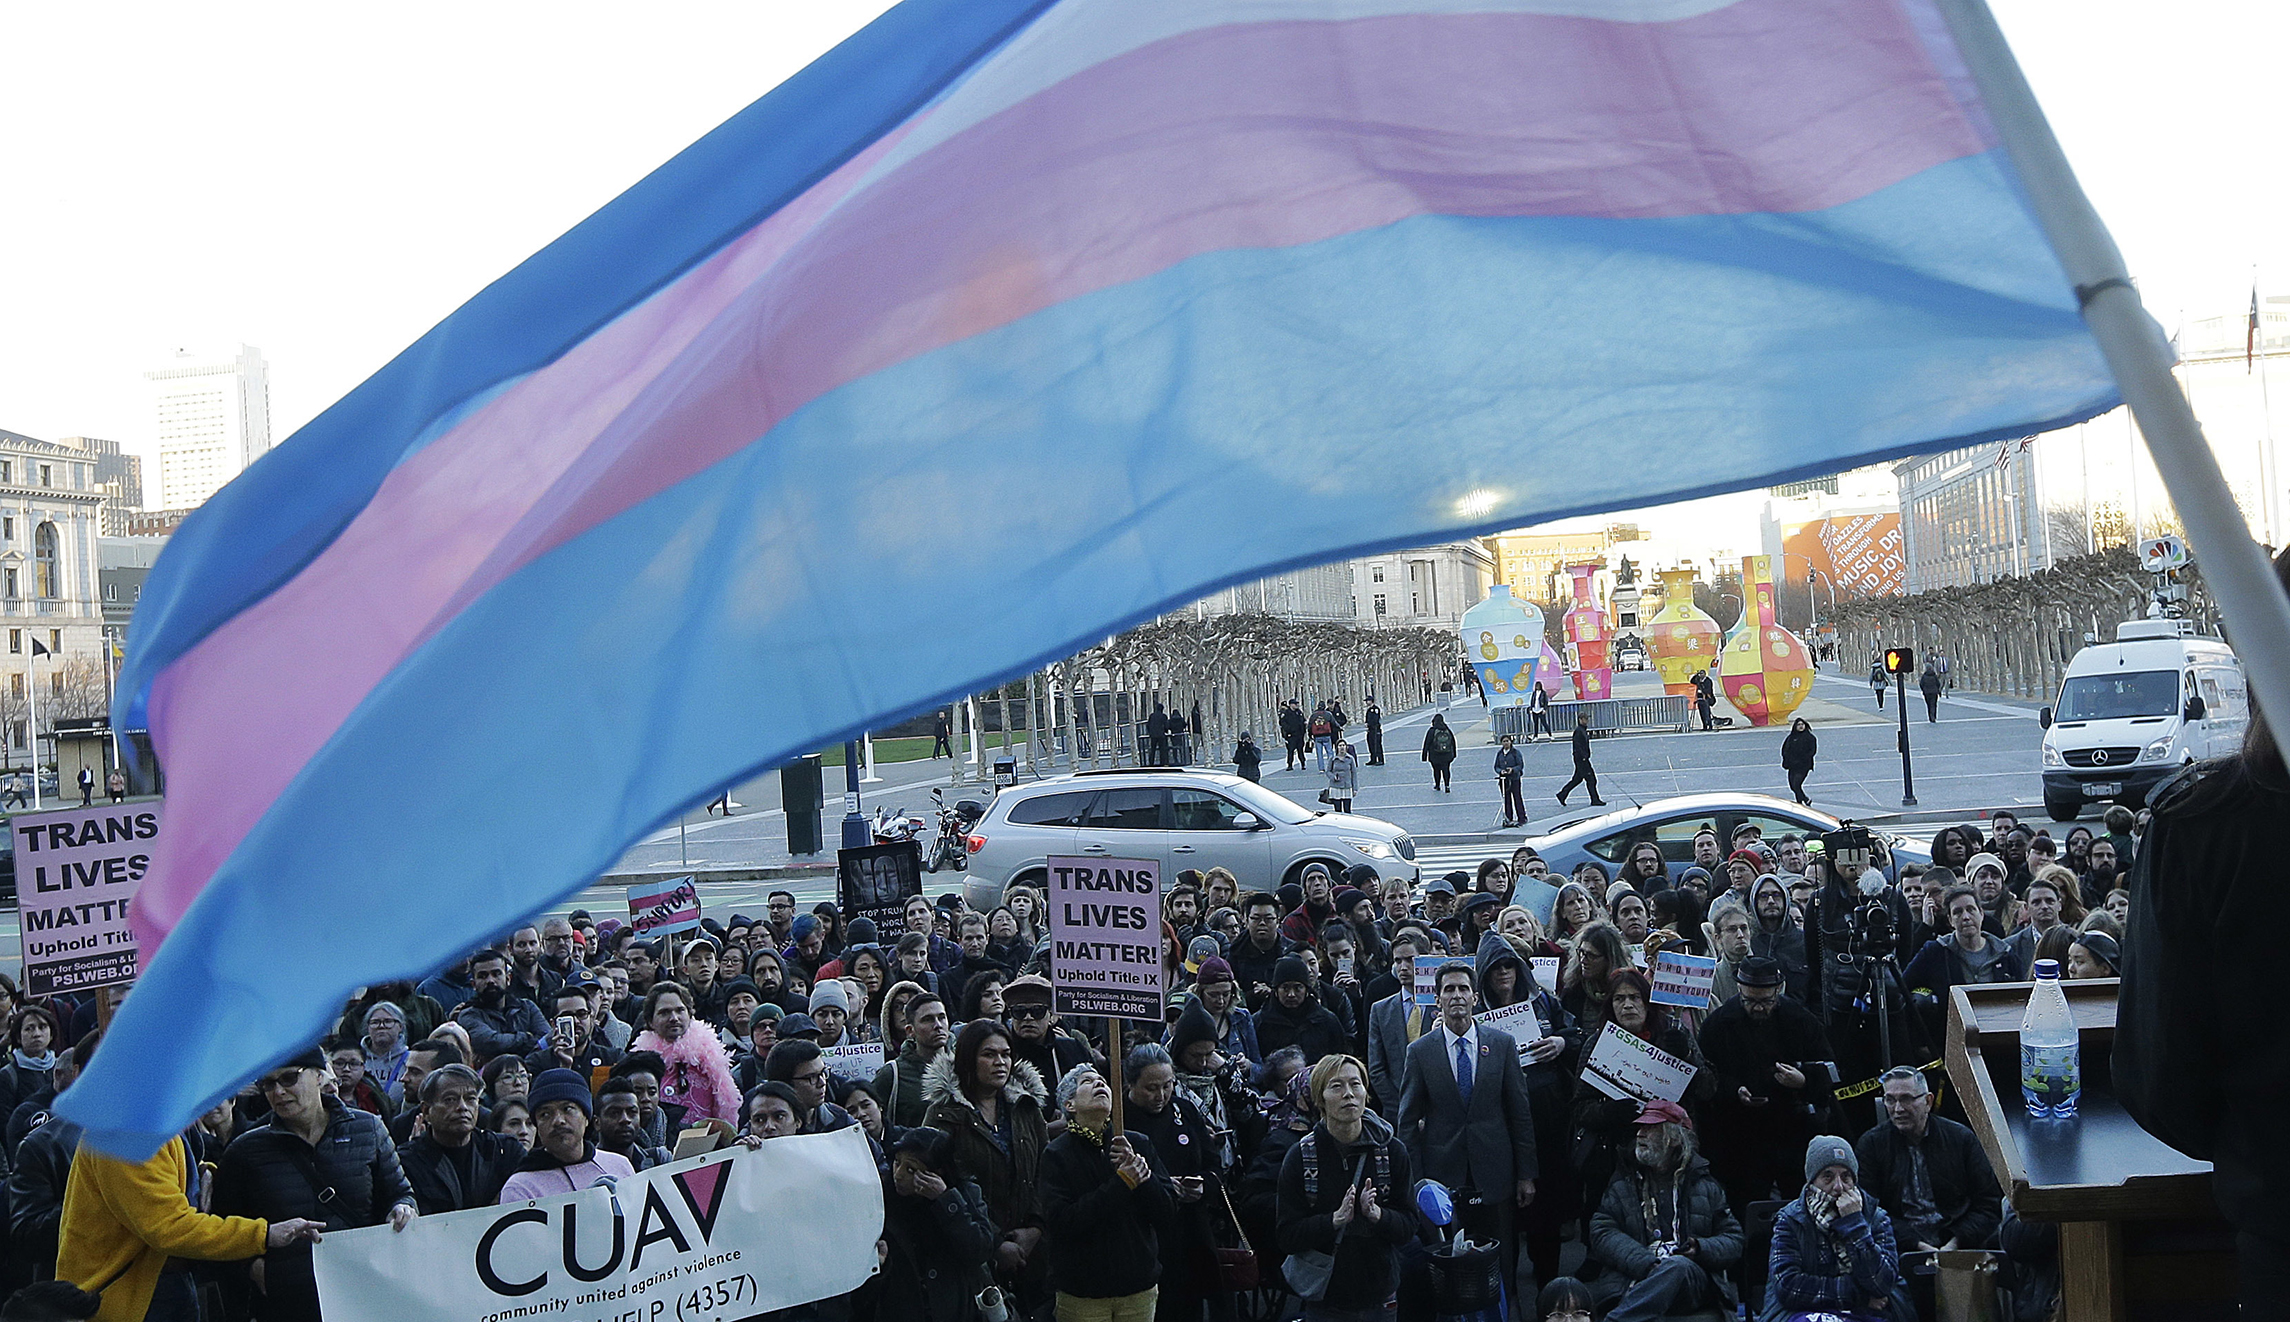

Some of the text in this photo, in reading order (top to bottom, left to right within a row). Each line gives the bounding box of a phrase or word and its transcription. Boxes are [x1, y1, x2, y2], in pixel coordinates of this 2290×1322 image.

[1836, 513, 1885, 556] TRANSFORMS
[1838, 535, 1873, 568] THROUGH
[1878, 549, 1904, 578] JOY
[1836, 549, 1885, 591] MUSIC,
[19, 813, 158, 852] TRANS
[35, 855, 150, 893] LIVES
[849, 854, 912, 906] NO!
[1054, 867, 1154, 894] TRANS
[637, 876, 697, 935] SUPPORT
[857, 909, 879, 918] STOP
[1064, 903, 1147, 930] LIVES
[30, 934, 98, 957] Uphold
[1056, 941, 1157, 965] MATTER!
[32, 968, 56, 977] Party
[59, 964, 72, 973] for
[74, 958, 117, 971] Socialism
[119, 955, 126, 963] &
[1057, 968, 1158, 986] Uphold Title IX
[1657, 963, 1691, 975] SHOW
[1653, 982, 1711, 998] TRANS YOUTH
[1683, 977, 1688, 985] 4
[1058, 990, 1075, 999] Party
[1077, 991, 1086, 999] for
[1088, 992, 1119, 1000] Socialism
[1127, 994, 1158, 1003] Liberation
[1072, 999, 1146, 1014] PSLWEB.ORG
[850, 1057, 864, 1068] UP
[1607, 1024, 1694, 1076] #GSAs4Justice
[475, 1159, 735, 1296] CUAV
[481, 1250, 742, 1322] community united against violence
[676, 1273, 758, 1322] (4357)
